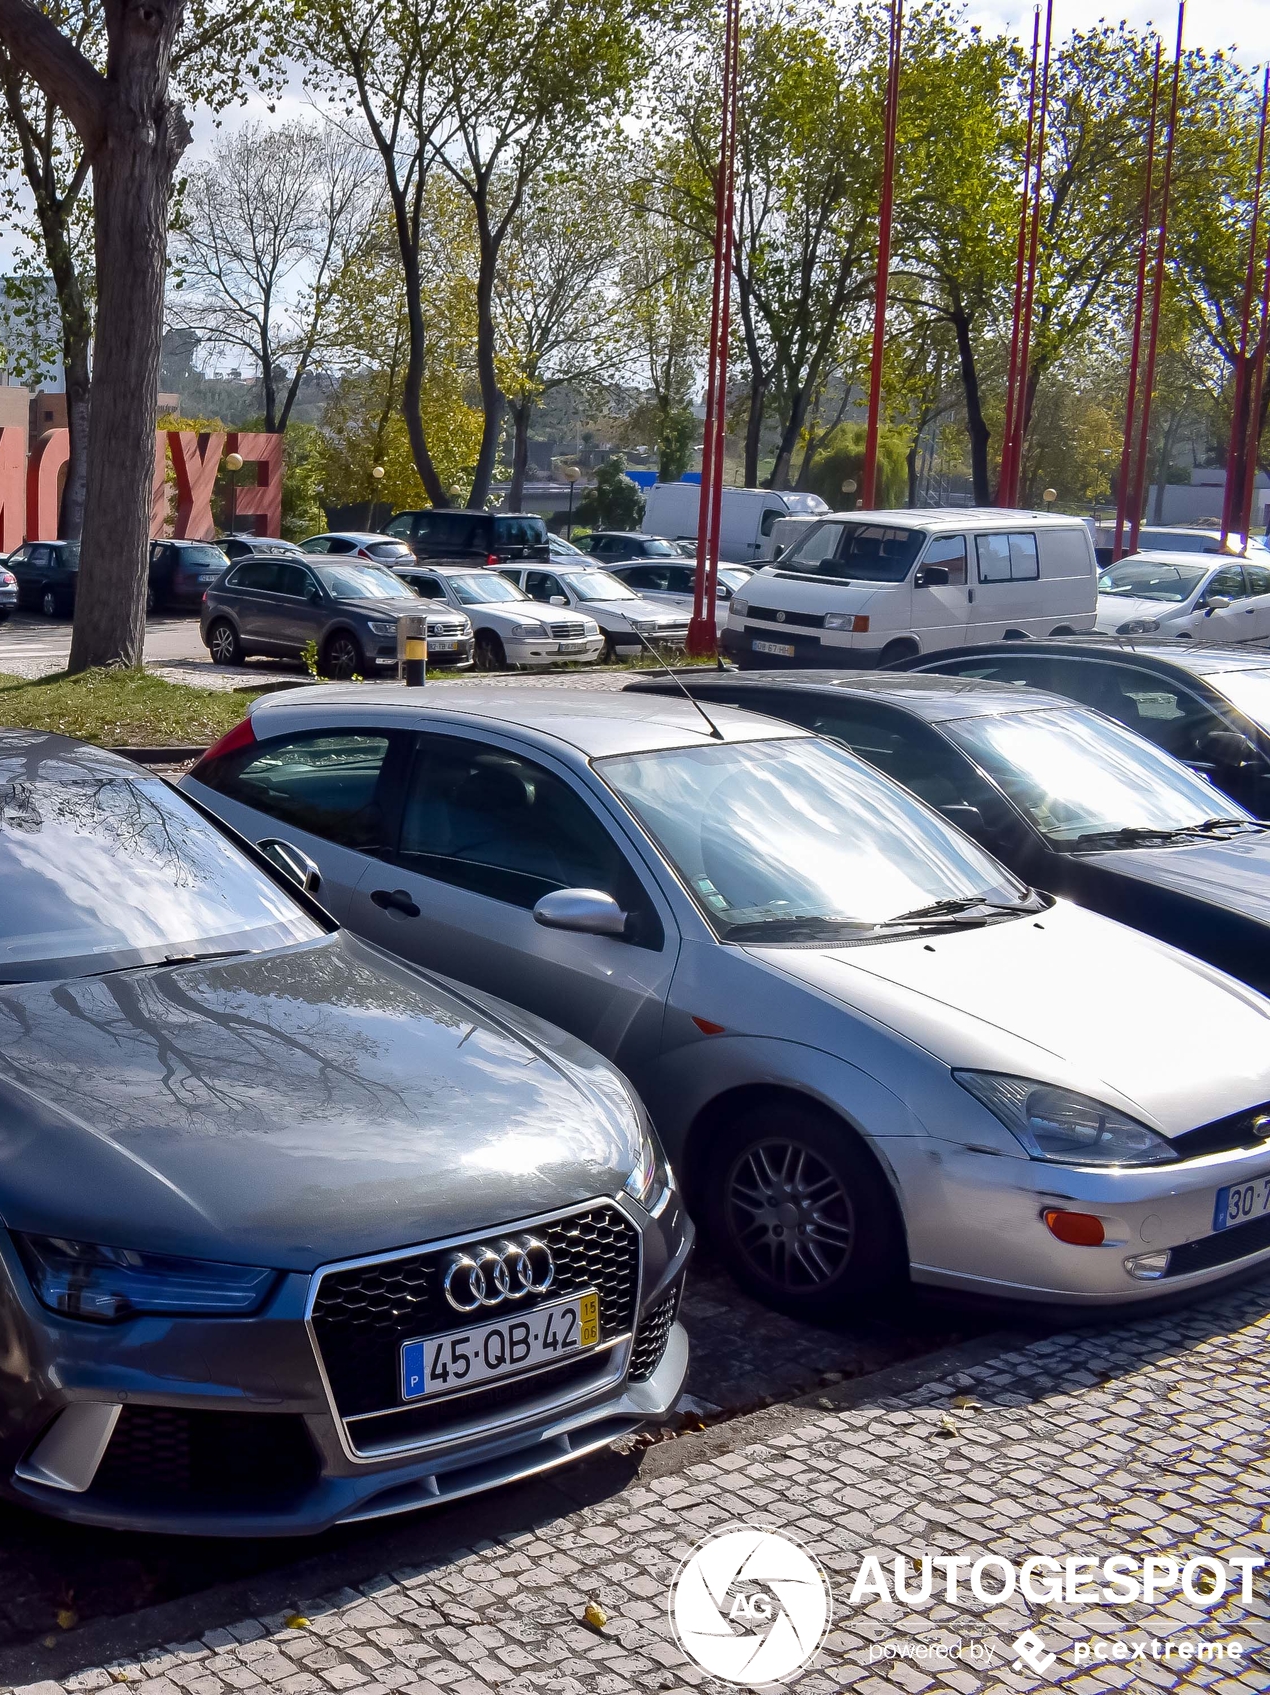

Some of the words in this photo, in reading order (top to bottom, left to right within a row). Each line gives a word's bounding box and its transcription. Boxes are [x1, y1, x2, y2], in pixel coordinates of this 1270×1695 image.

[584, 1300, 597, 1316] 15
[583, 1325, 597, 1340] 06
[410, 1375, 419, 1387] P
